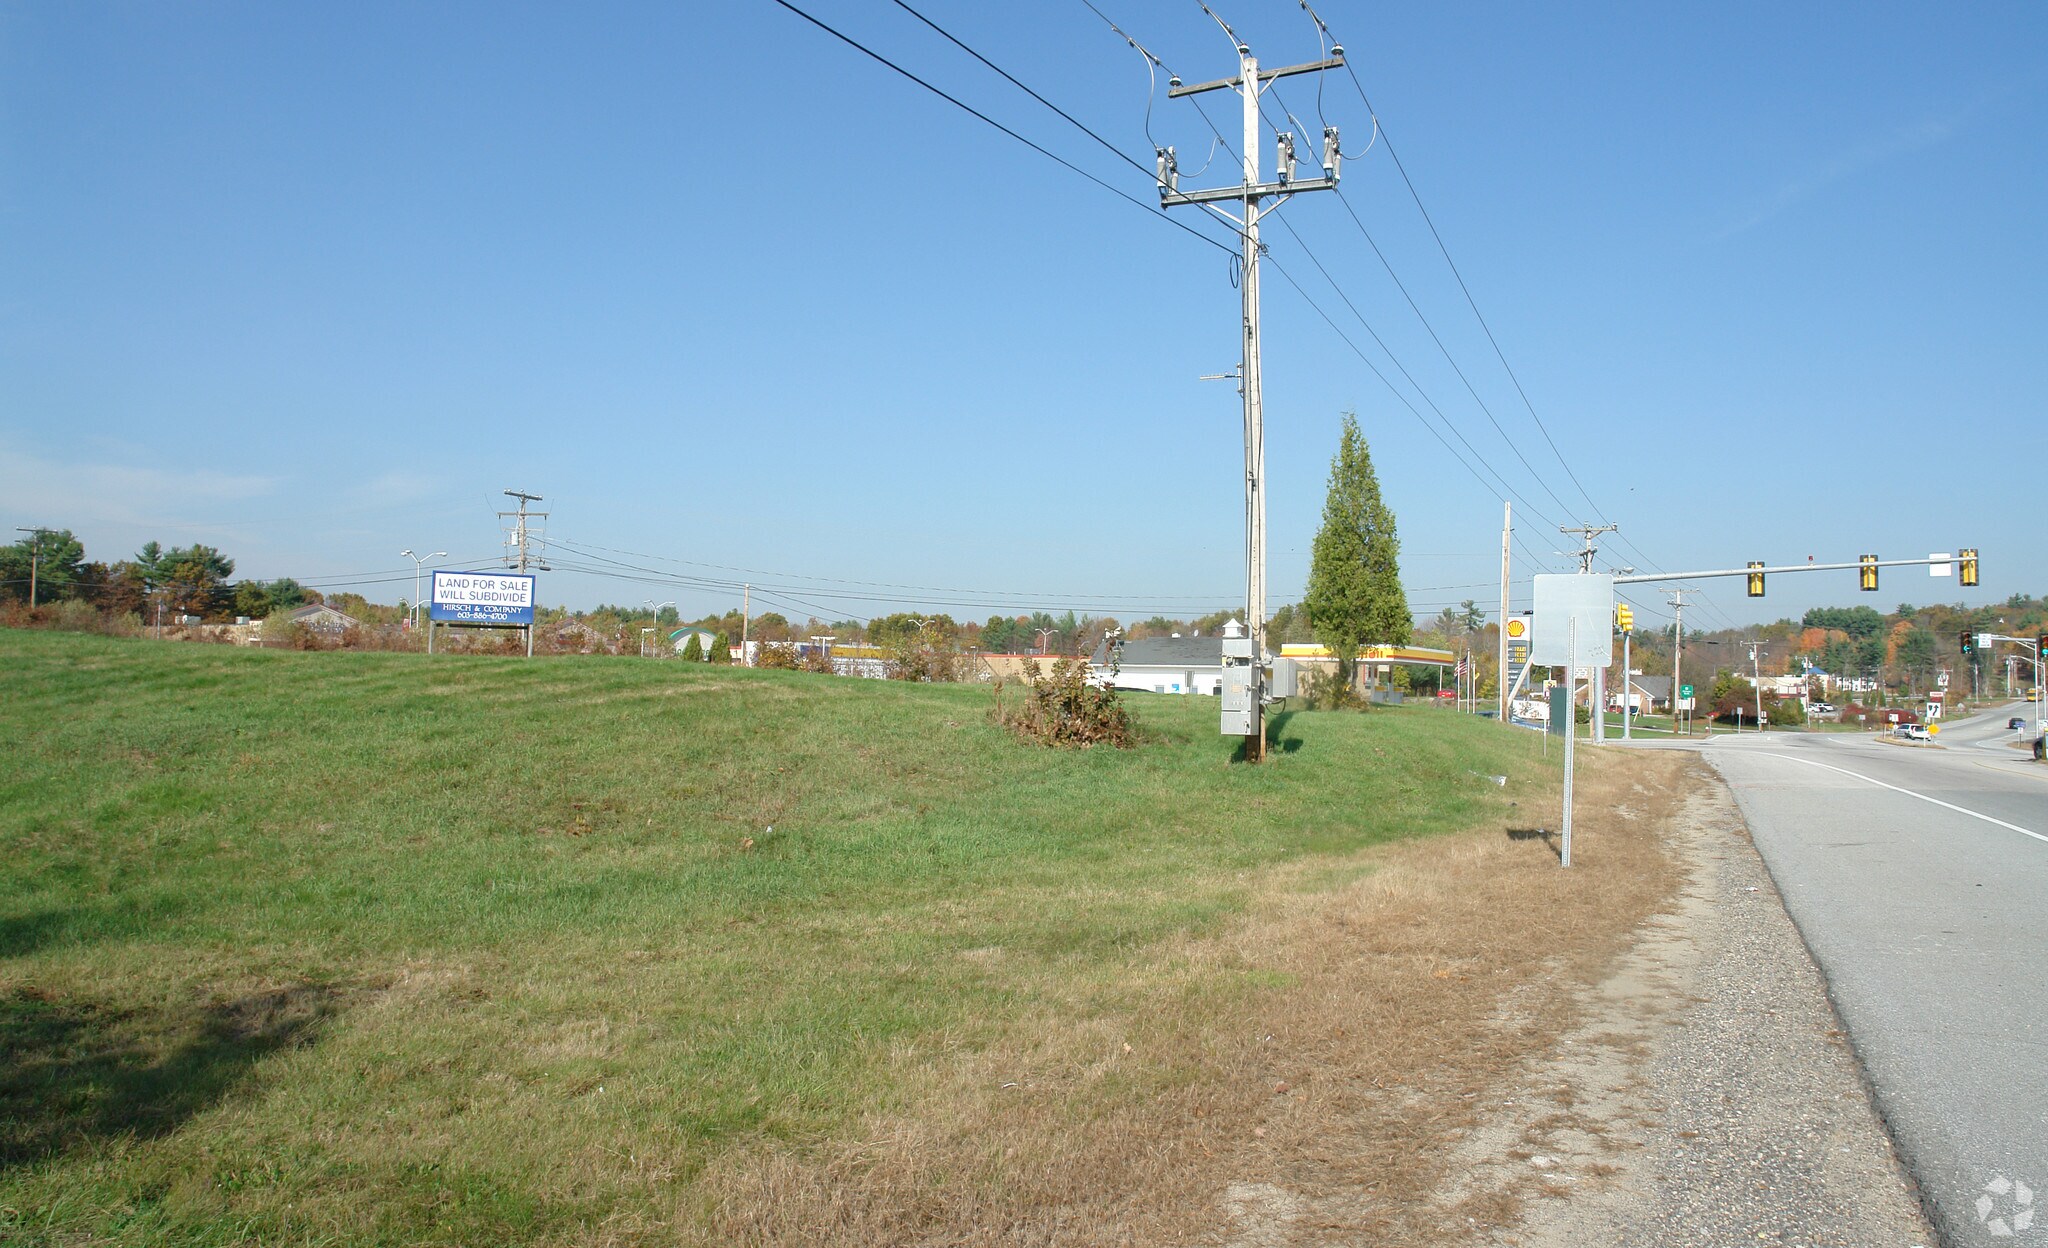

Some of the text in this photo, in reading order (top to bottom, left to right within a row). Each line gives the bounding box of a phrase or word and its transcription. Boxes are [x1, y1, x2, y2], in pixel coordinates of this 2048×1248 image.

[438, 578, 528, 591] LAND FOR SALE
[440, 590, 527, 602] WILL SUBDIVIDE
[484, 606, 522, 614] COMPANY
[457, 612, 508, 620] 603-886-4700
